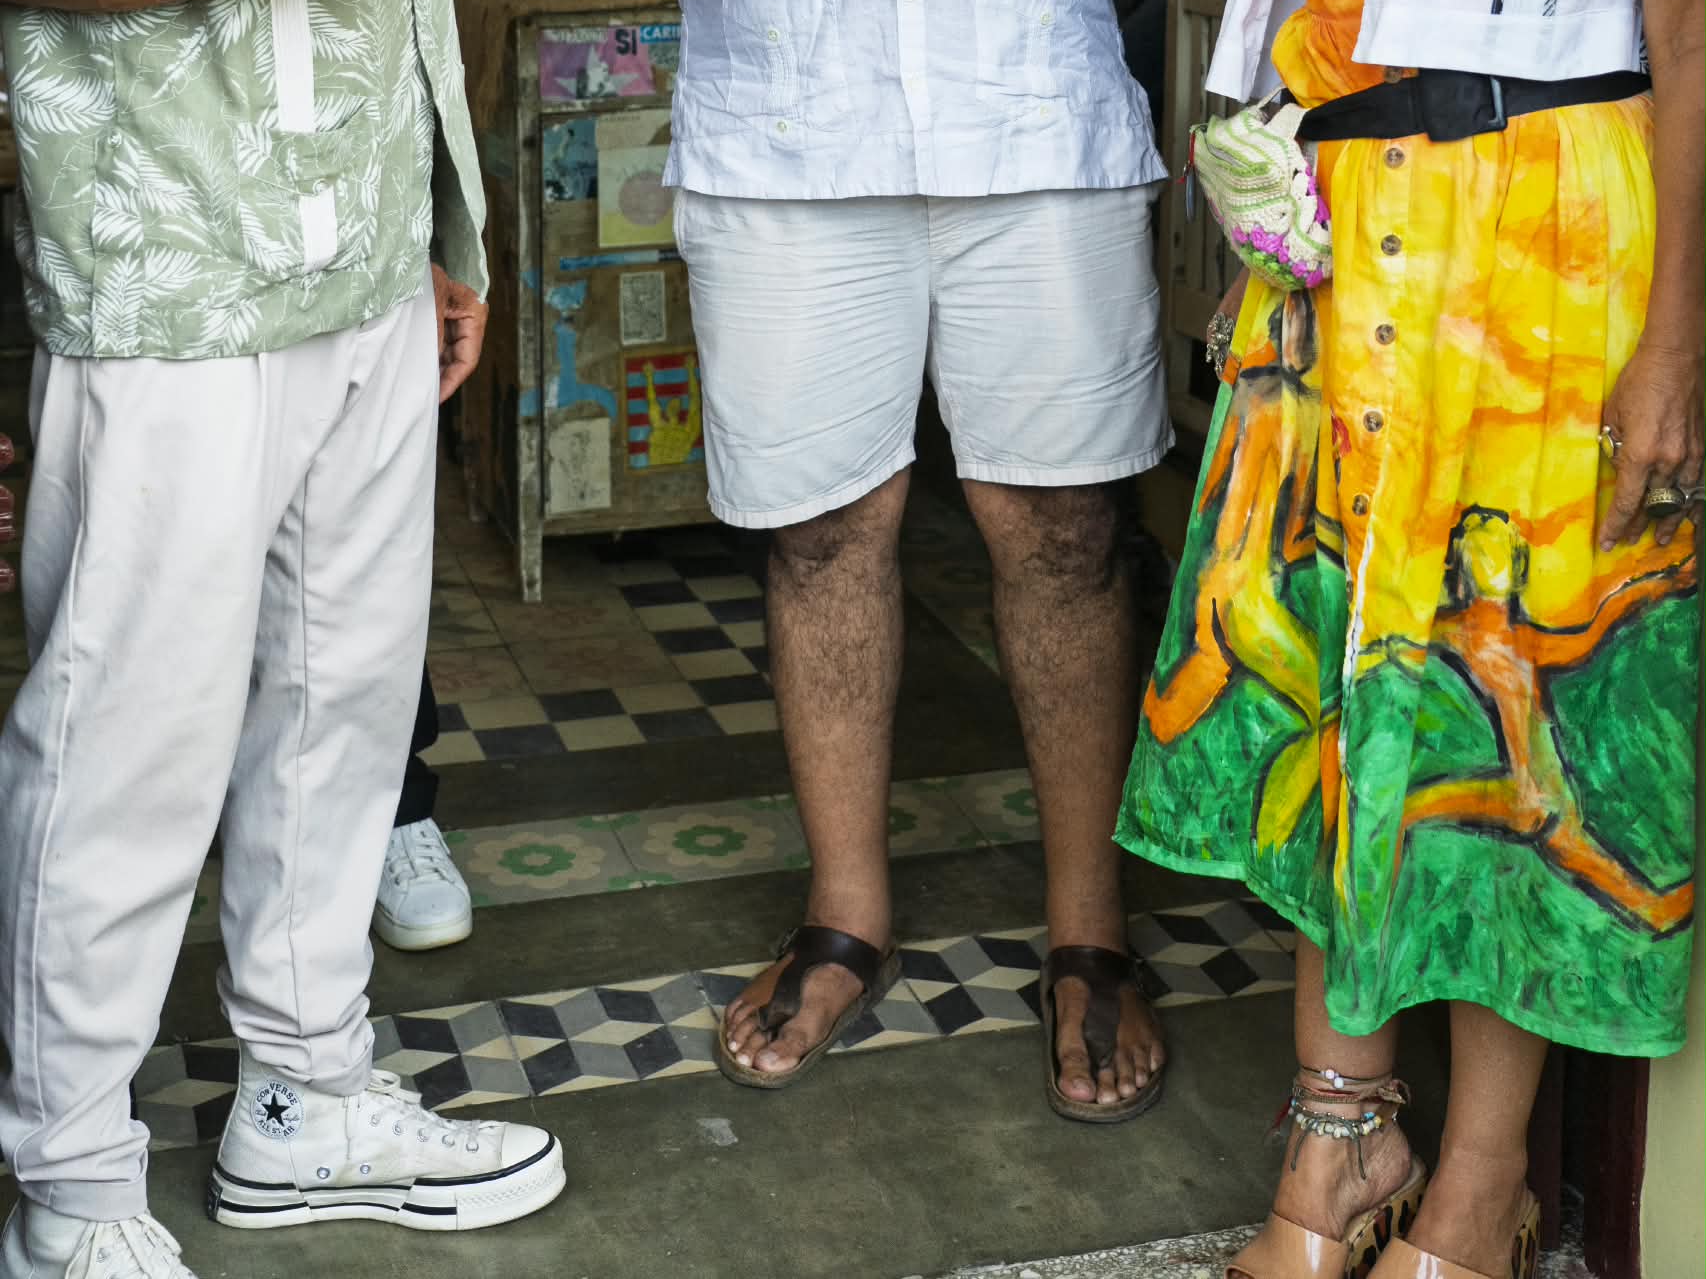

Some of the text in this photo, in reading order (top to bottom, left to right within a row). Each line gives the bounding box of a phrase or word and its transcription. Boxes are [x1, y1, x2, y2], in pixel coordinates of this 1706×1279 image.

[643, 25, 681, 39] CARI
[615, 28, 637, 56] SI
[256, 1082, 298, 1106] CONVERSE
[258, 1119, 270, 1132] ALL
